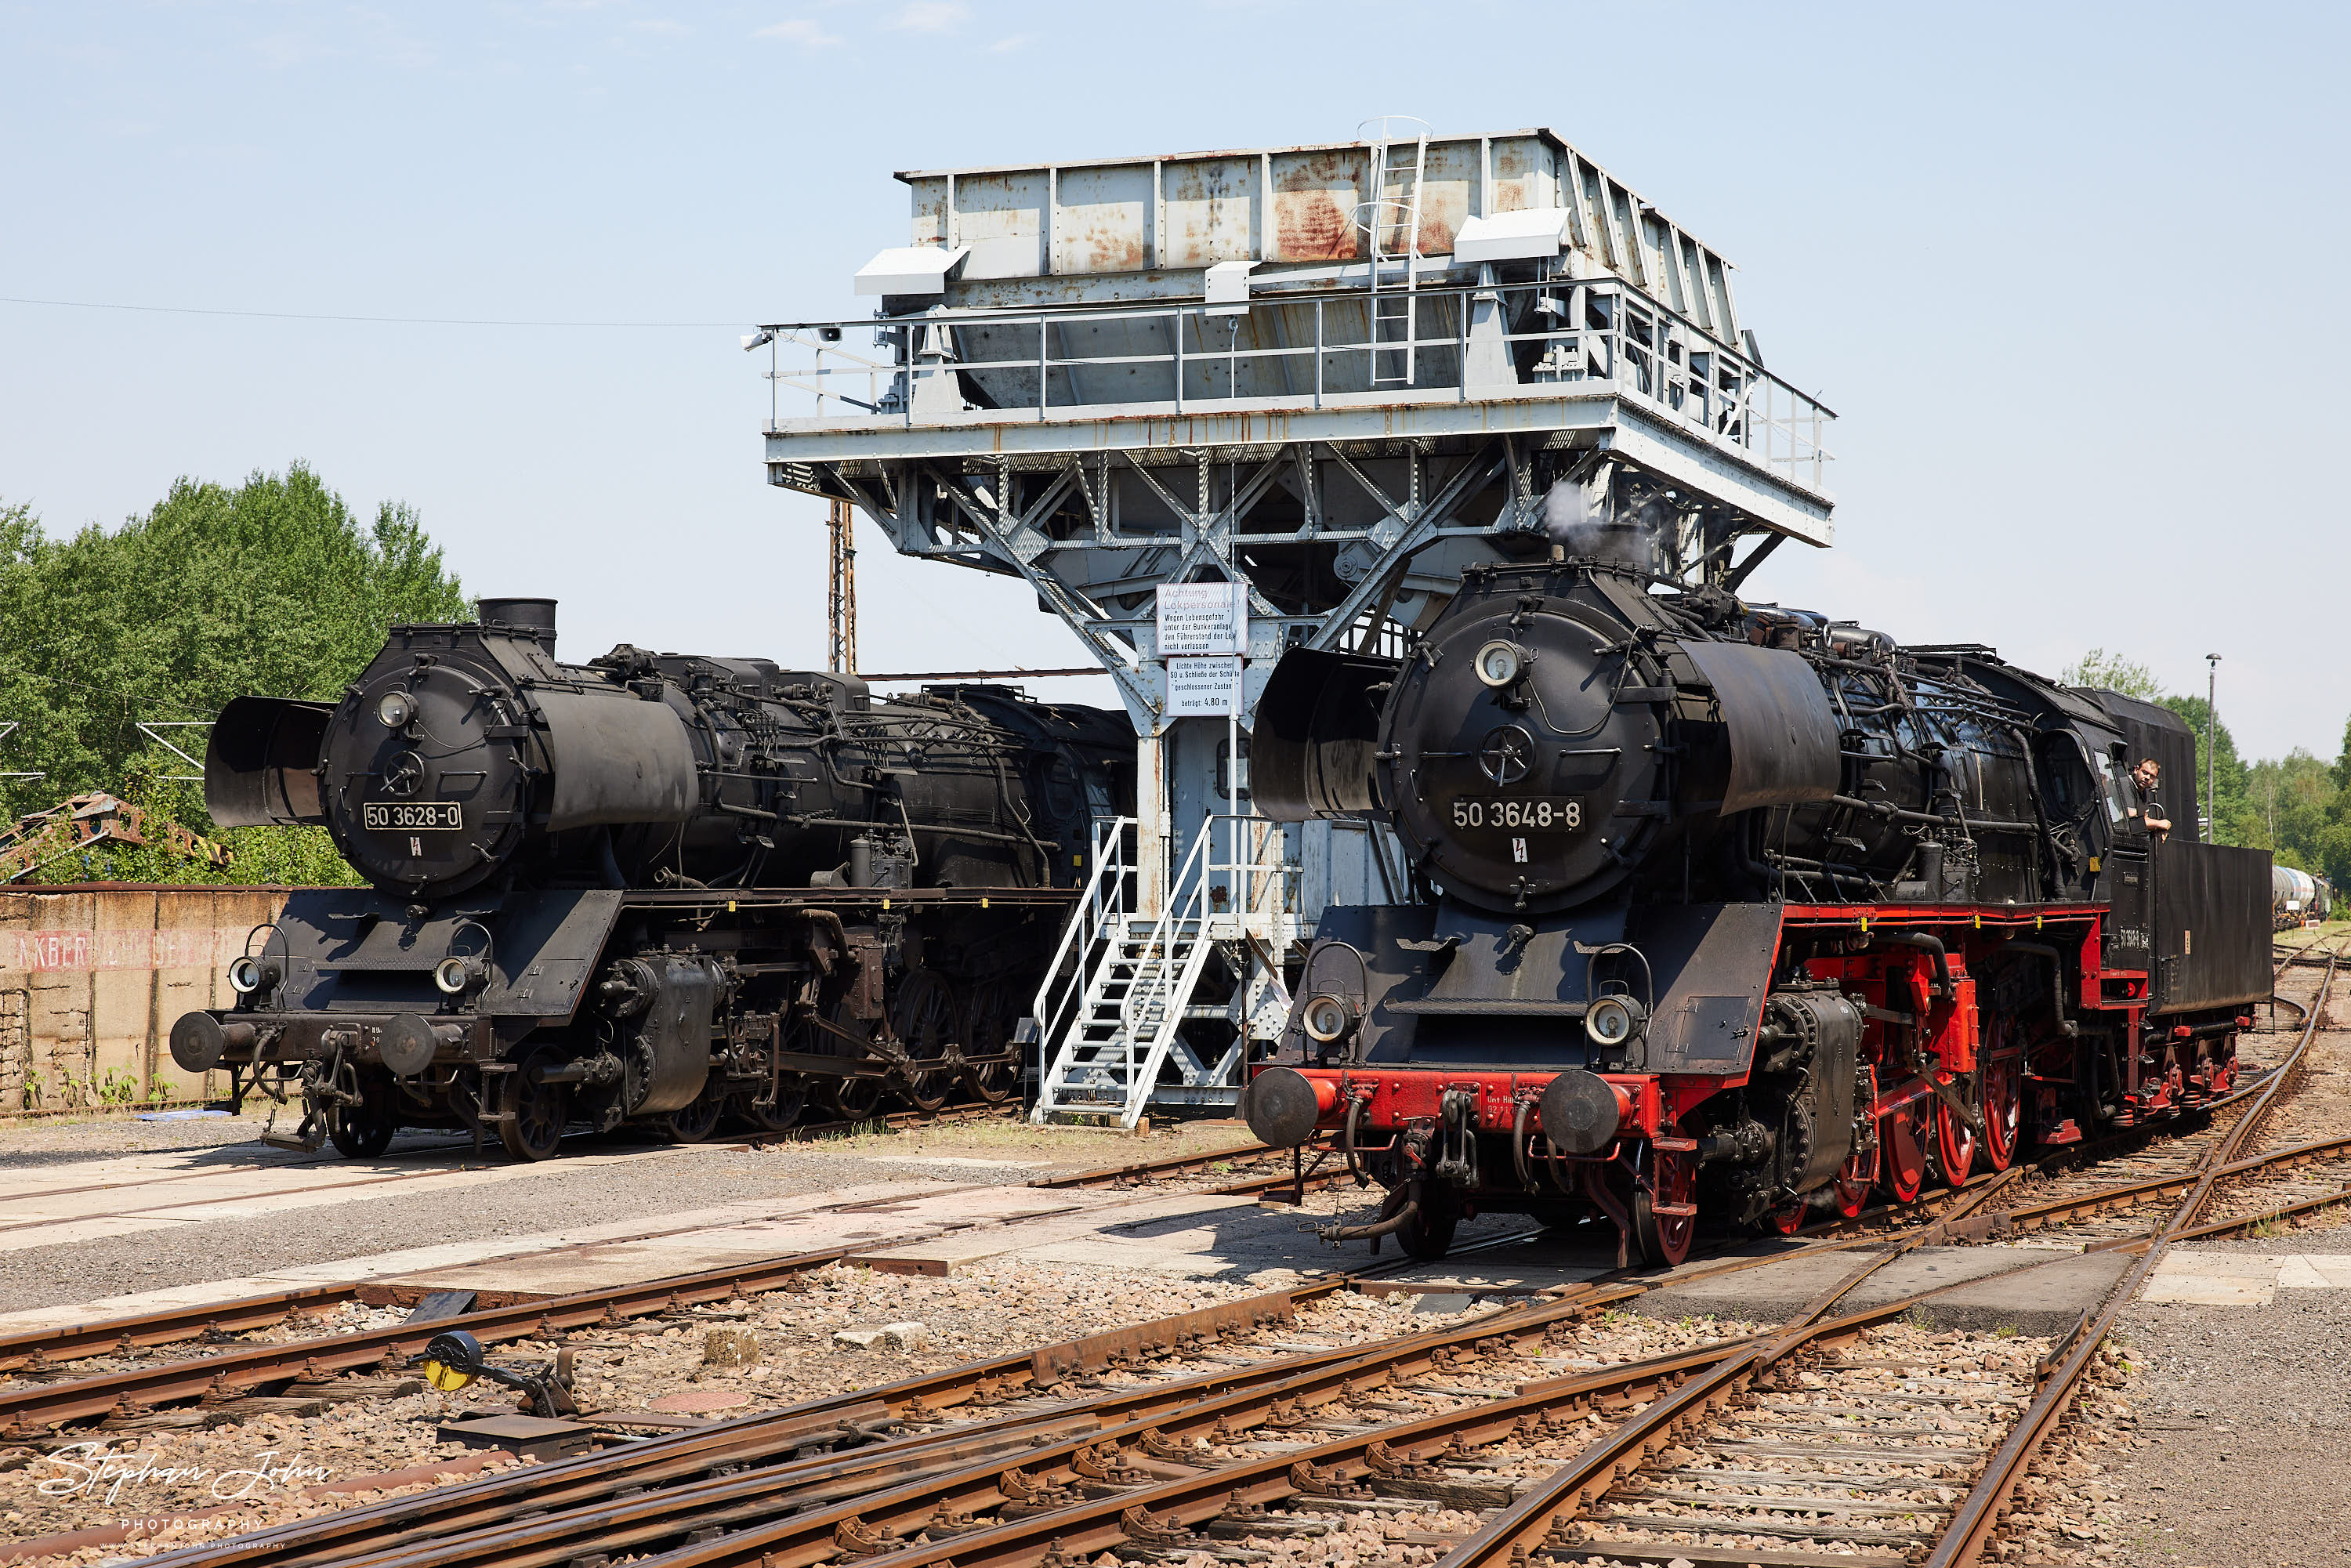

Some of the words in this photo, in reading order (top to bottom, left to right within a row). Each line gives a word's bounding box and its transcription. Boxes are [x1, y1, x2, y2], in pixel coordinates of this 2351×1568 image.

[1186, 613, 1224, 621] Lebensgefahr
[1204, 697, 1219, 707] 4.80
[367, 806, 389, 826] 50
[393, 806, 458, 826] 3628-0
[1454, 802, 1483, 827] 50
[1490, 802, 1581, 827] 3648-8
